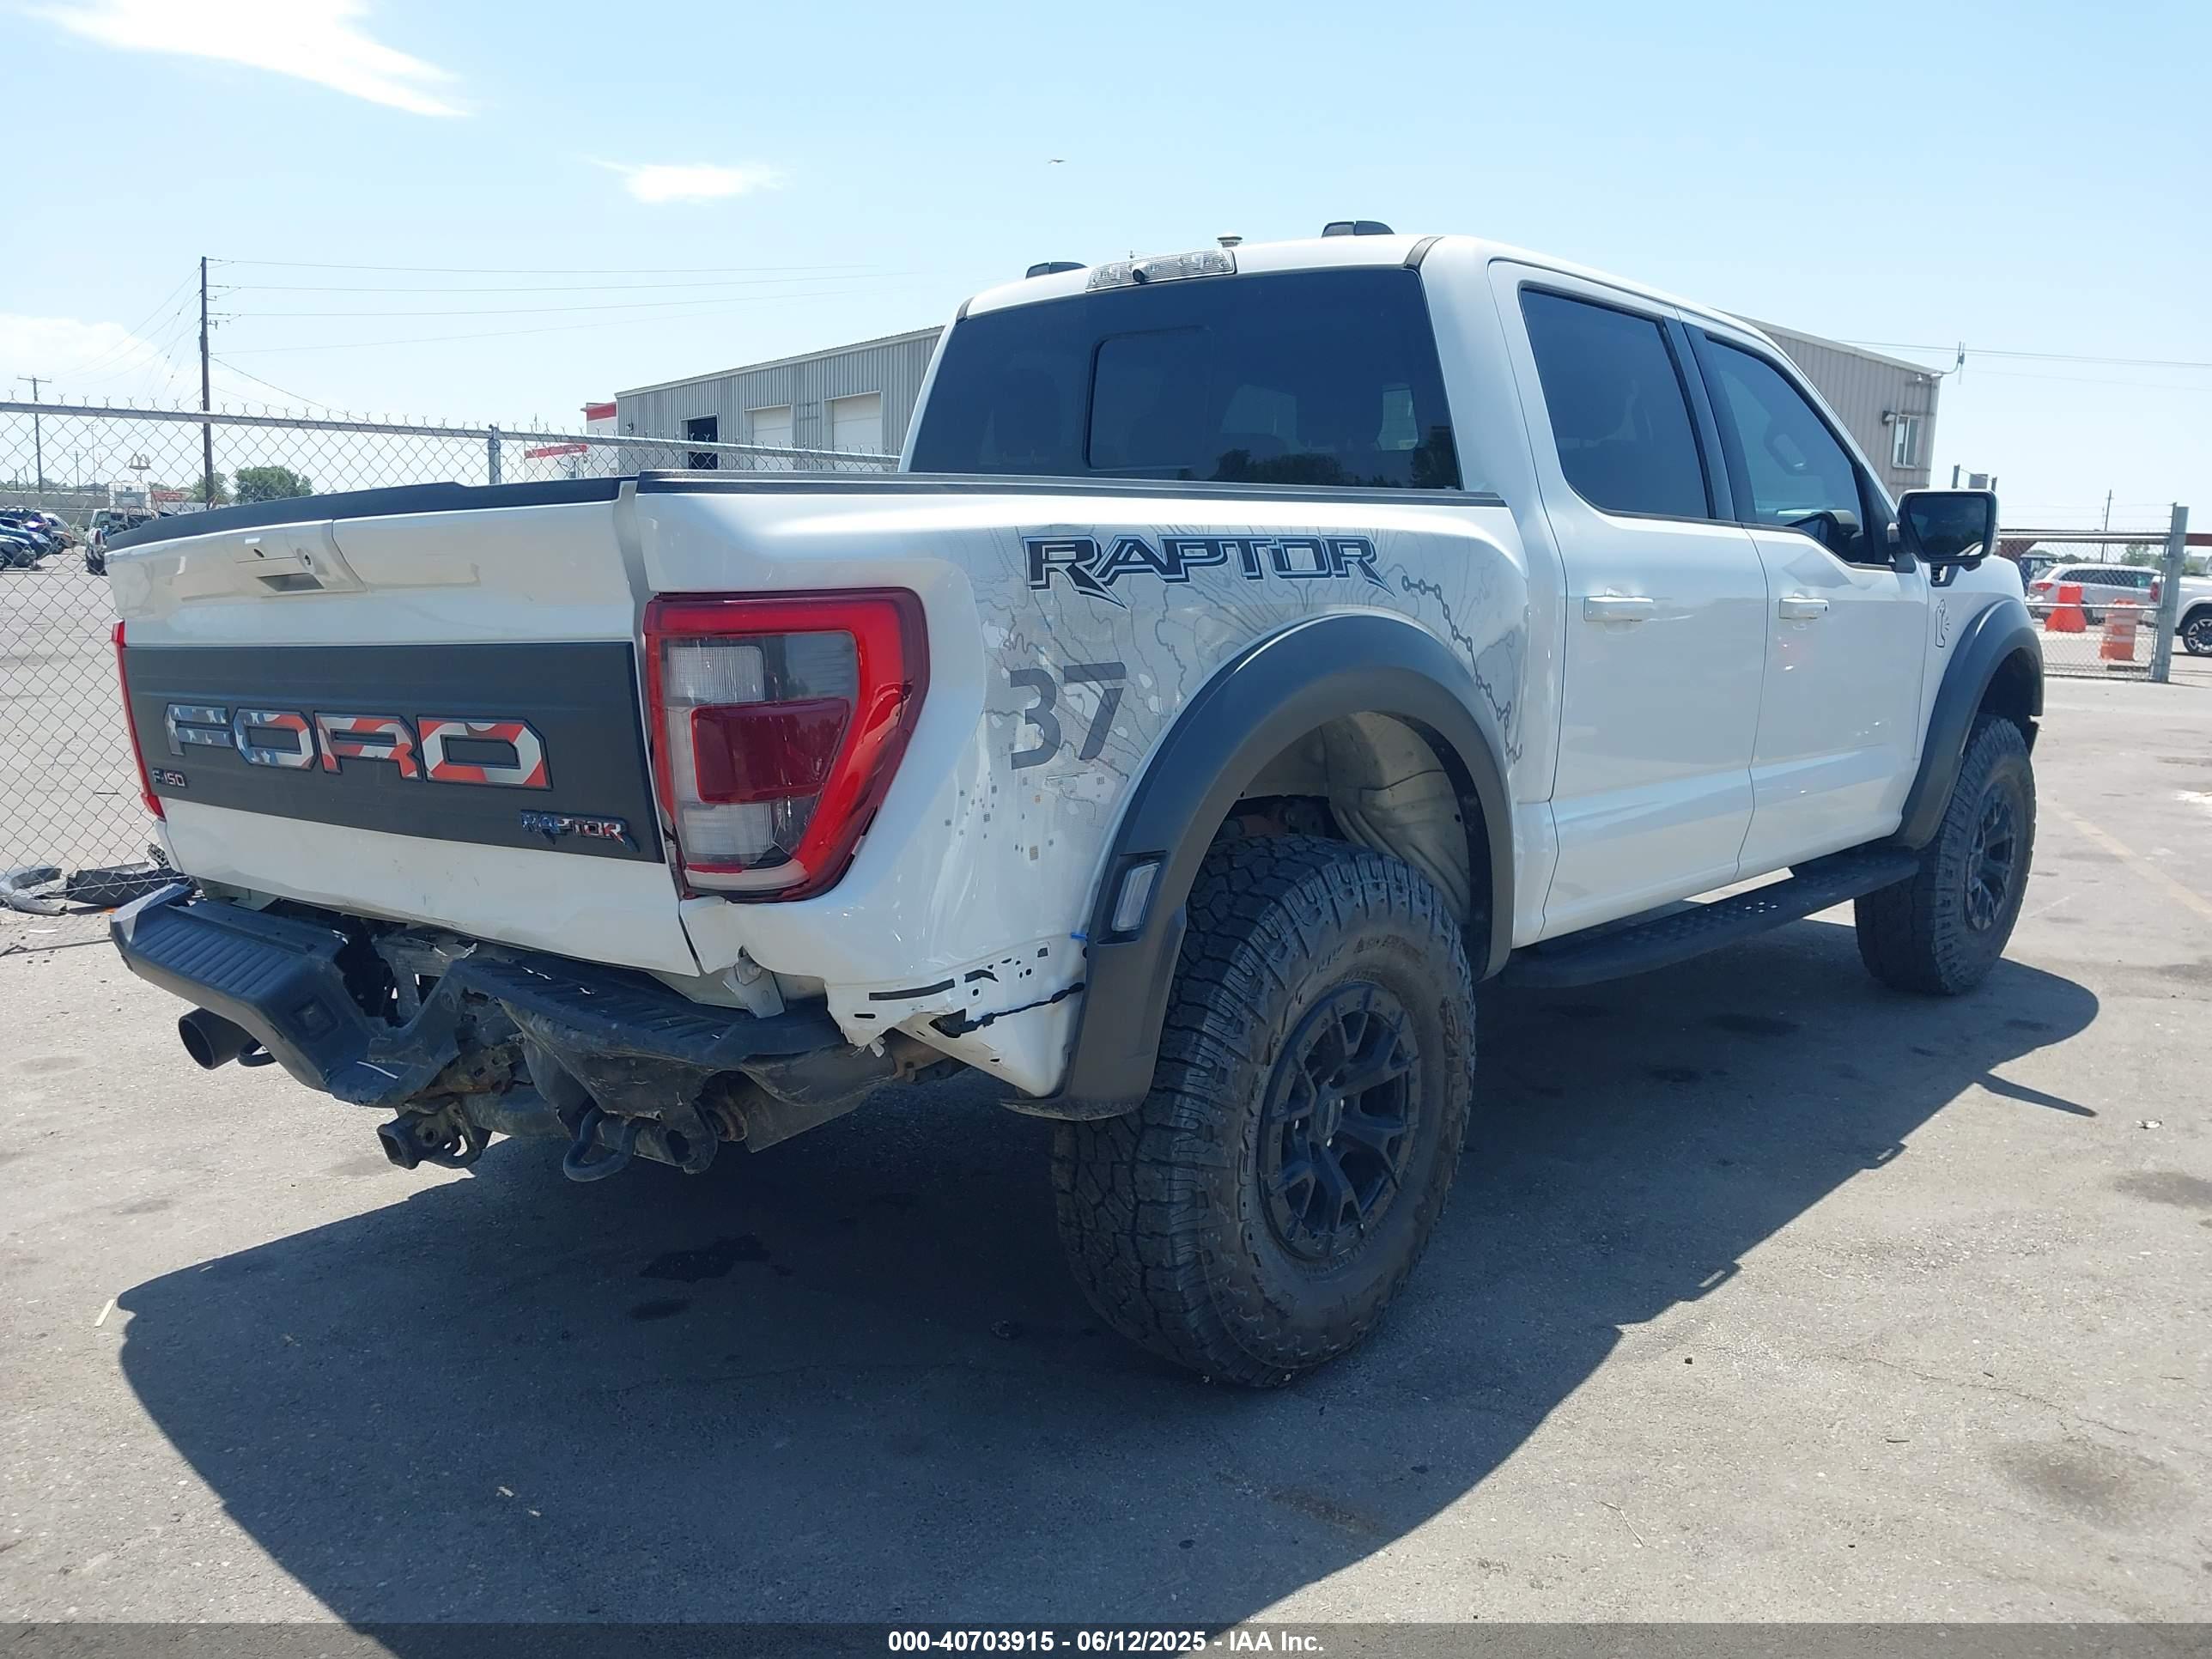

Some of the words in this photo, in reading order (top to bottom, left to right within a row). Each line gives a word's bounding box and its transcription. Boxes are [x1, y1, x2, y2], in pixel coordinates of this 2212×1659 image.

[1022, 534, 1397, 611] RAPTOR
[163, 702, 553, 790] FORD
[1009, 661, 1127, 770] 37
[152, 769, 187, 787] F-150
[520, 810, 636, 848] RAPTOR
